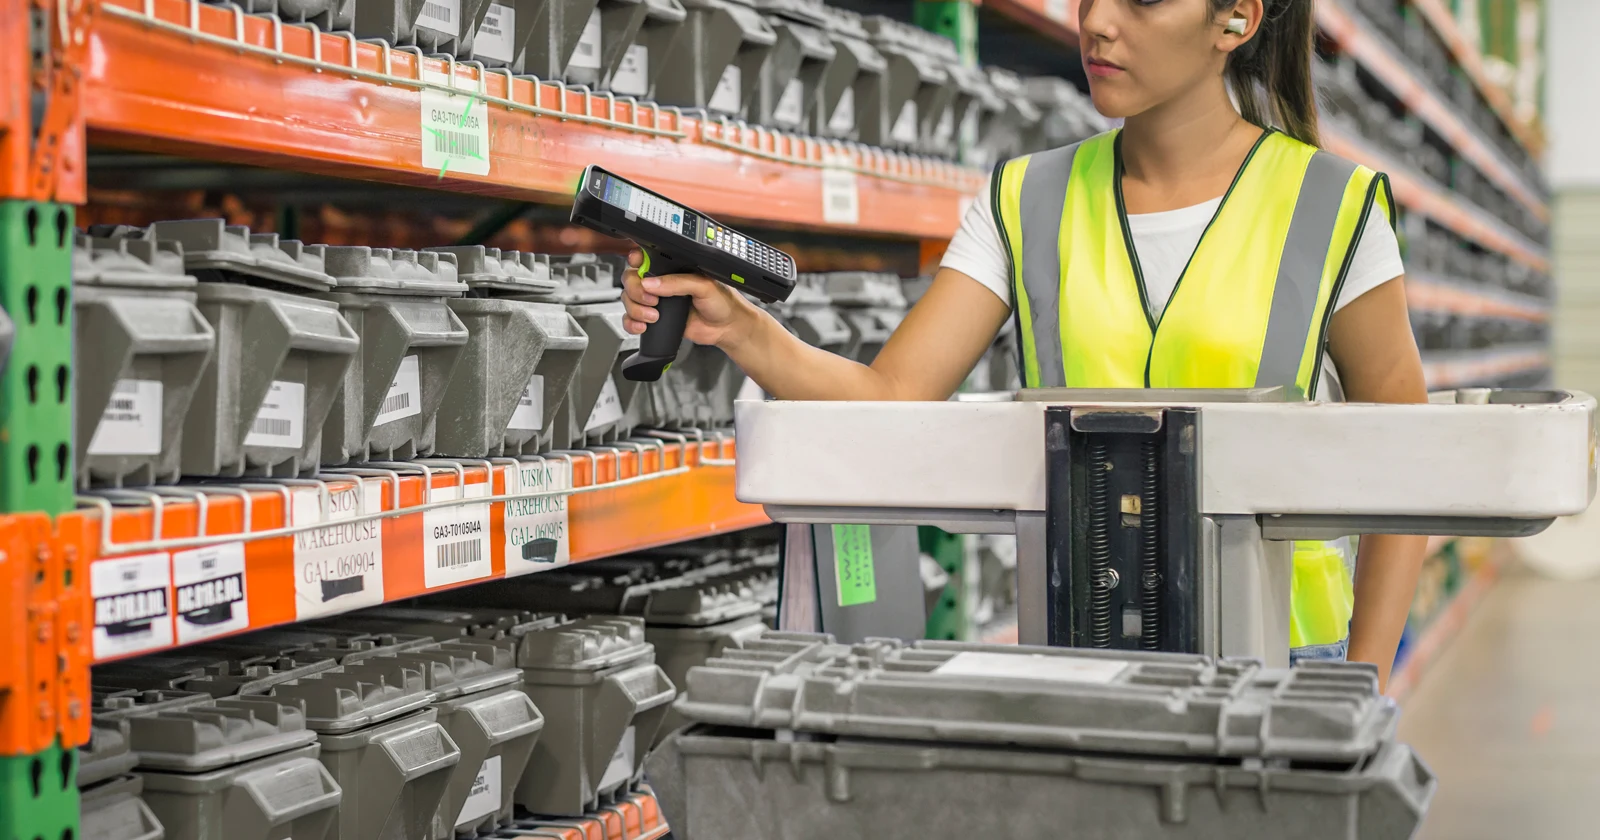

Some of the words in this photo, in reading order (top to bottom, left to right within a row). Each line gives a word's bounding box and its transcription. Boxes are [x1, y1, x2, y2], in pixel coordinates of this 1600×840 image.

[506, 495, 565, 518] WAREHOUSE
[297, 519, 378, 550] WAREHOUSE
[433, 520, 482, 539] GA3-T010504A
[337, 551, 375, 578] 060904
